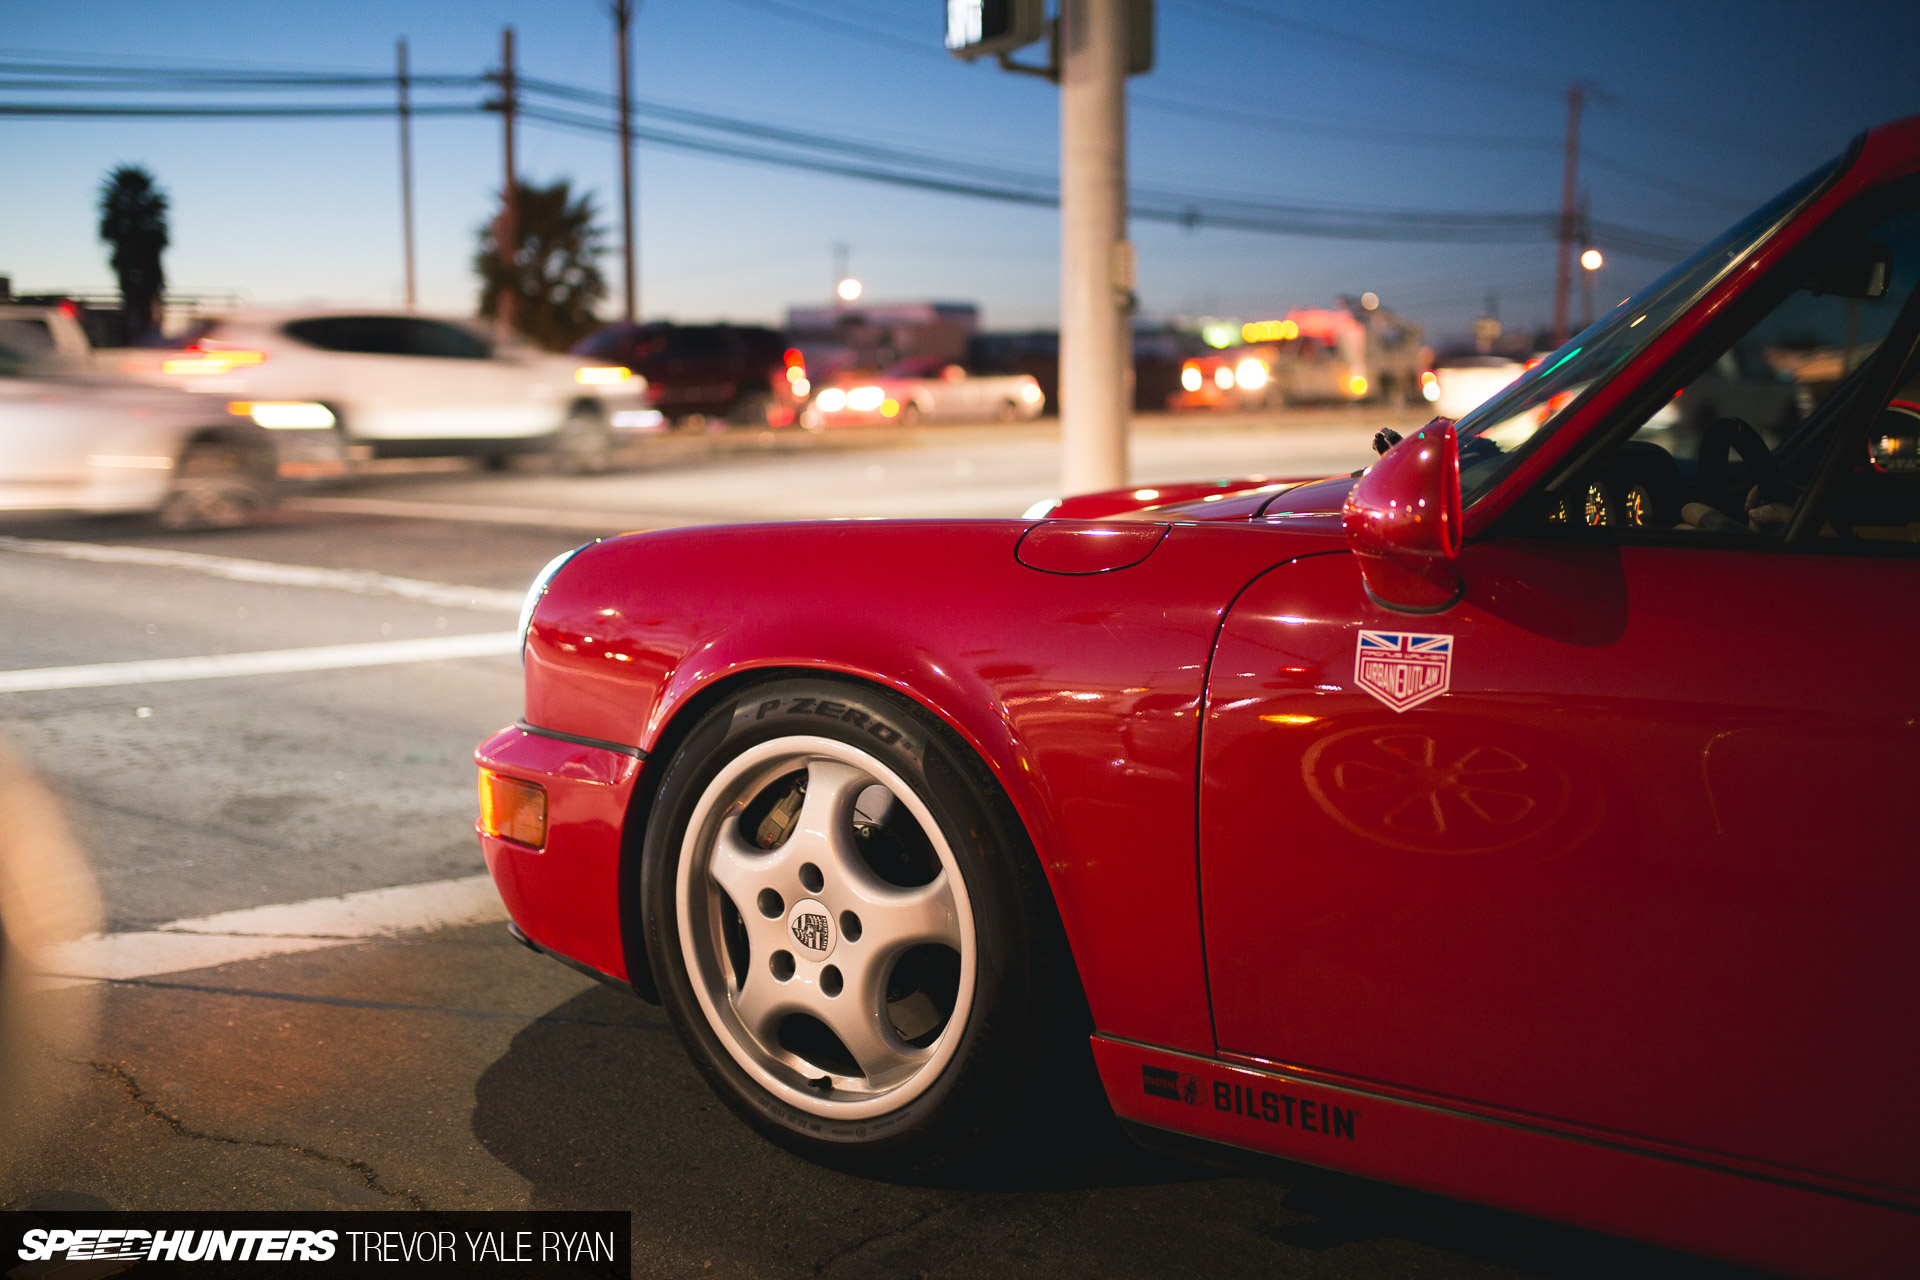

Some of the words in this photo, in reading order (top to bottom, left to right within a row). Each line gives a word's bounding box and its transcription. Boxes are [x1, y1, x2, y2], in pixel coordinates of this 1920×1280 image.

[756, 699, 781, 720] P
[787, 698, 902, 745] ZERO
[1213, 1080, 1355, 1140] BILSTEIN
